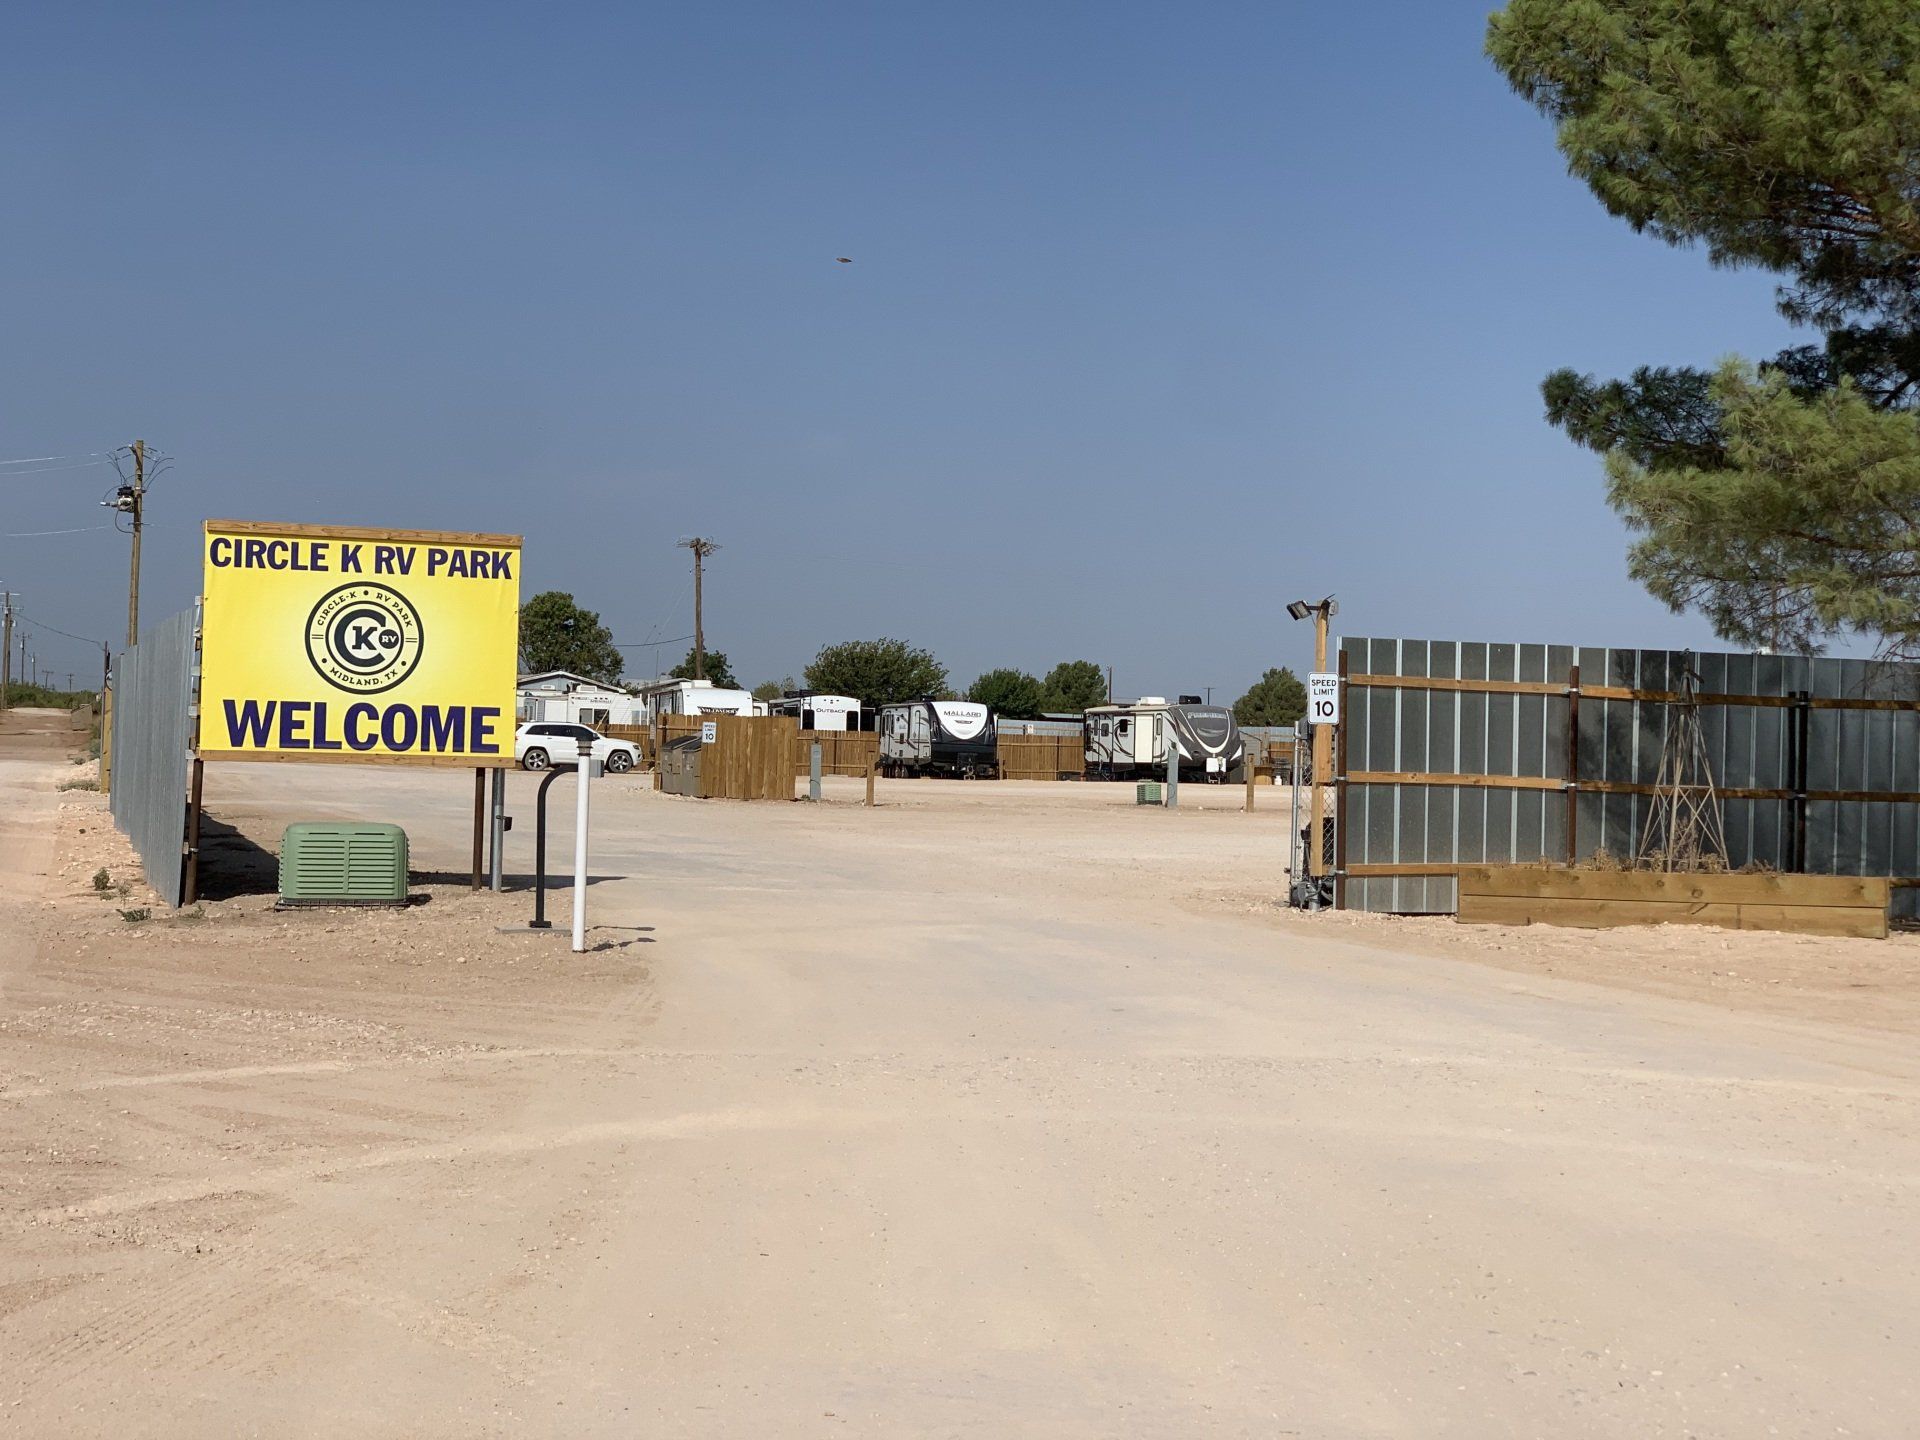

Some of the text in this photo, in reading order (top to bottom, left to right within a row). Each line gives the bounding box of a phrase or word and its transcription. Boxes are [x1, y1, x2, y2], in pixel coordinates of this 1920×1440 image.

[209, 537, 513, 579] CIRCLE K RV PARK
[317, 591, 357, 626] CIRCLE-K
[375, 592, 413, 628] RV PARK
[381, 635, 397, 643] RV
[329, 667, 399, 686] MIDLAND, TX
[1311, 679, 1337, 687] SPEED
[1313, 688, 1335, 696] LIMIT
[943, 710, 982, 718] MALLARD
[1314, 700, 1334, 717] 10
[222, 699, 501, 754] WELCOME
